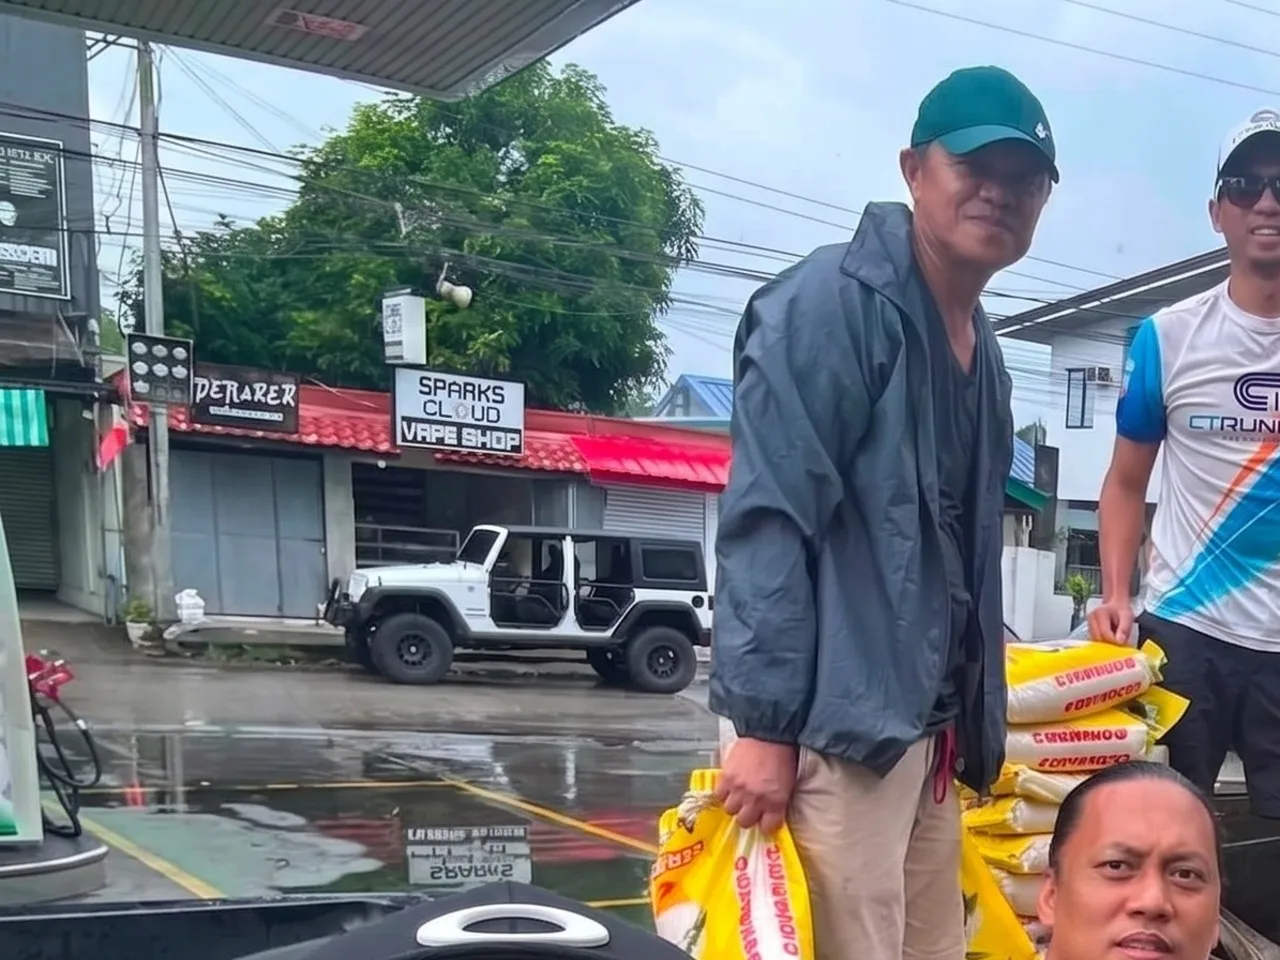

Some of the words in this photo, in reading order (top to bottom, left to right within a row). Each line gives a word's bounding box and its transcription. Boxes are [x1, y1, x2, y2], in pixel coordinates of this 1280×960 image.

[419, 376, 505, 404] SPARKS
[402, 421, 458, 445] VAPE
[461, 427, 521, 451] SHOP
